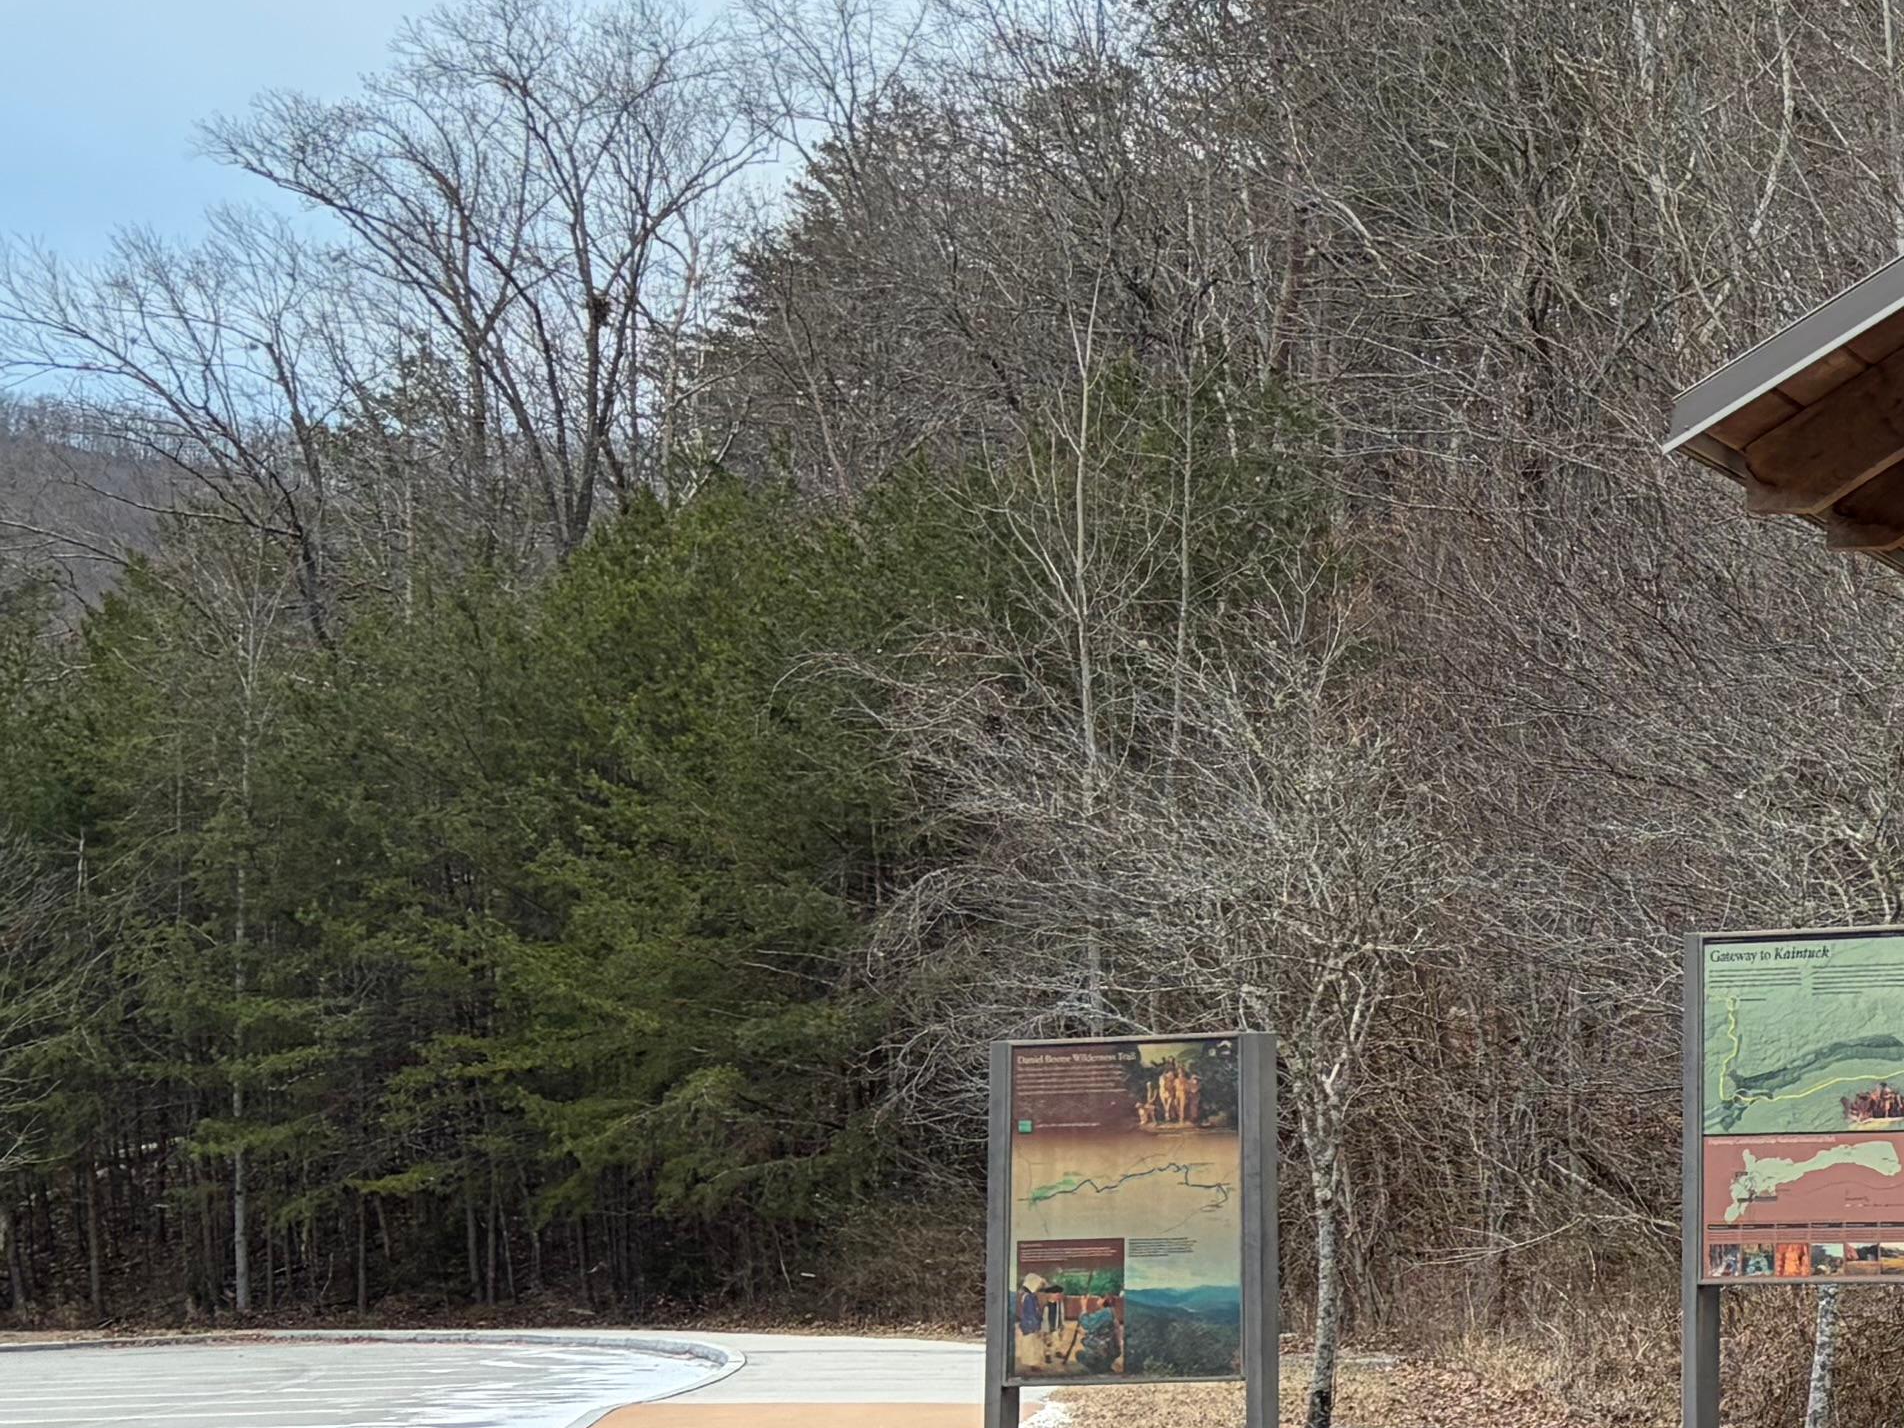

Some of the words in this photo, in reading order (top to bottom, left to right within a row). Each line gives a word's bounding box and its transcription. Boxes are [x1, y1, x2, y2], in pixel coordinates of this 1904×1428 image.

[1710, 949, 1757, 964] Gateway
[1760, 950, 1771, 961] to
[1774, 945, 1830, 960] Kaintuck
[1017, 1054, 1043, 1064] Daniel
[1117, 1052, 1136, 1061] Trail
